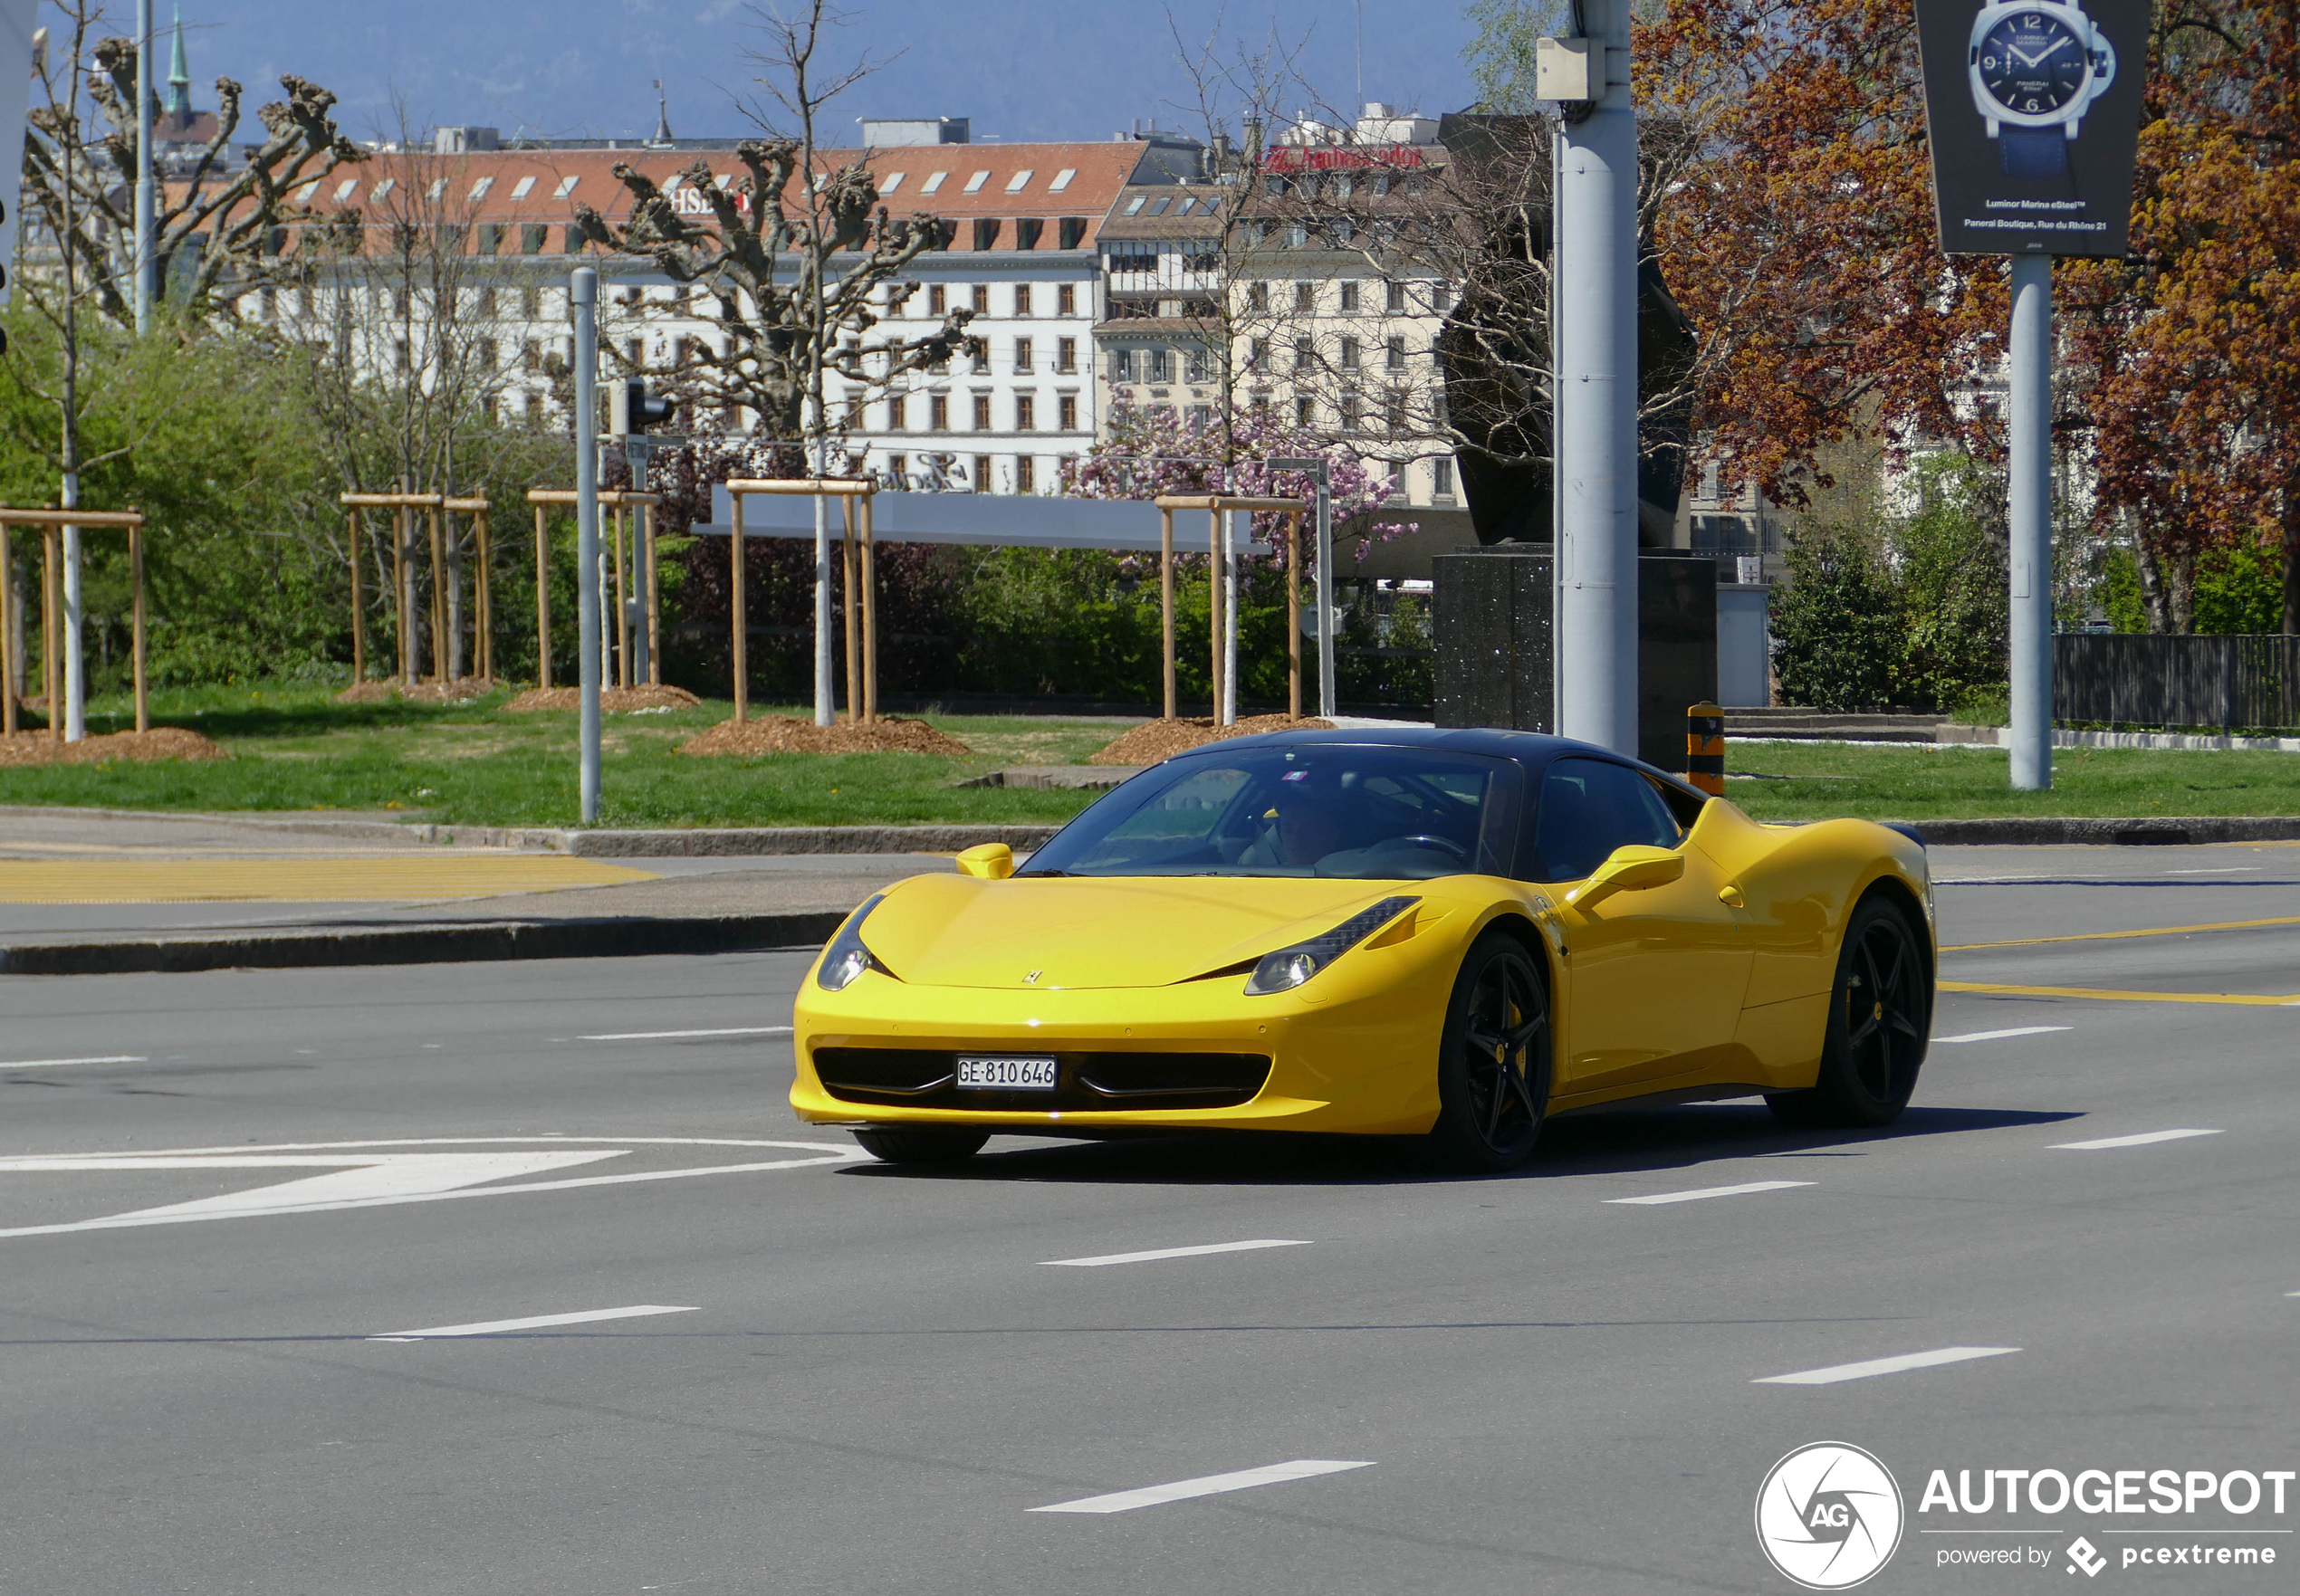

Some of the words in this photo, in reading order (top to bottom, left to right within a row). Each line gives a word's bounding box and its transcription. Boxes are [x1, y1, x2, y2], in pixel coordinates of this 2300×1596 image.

[2024, 14, 2042, 29] 12
[1984, 56, 1996, 70] 9
[2027, 99, 2038, 112] 6
[1986, 199, 2020, 208] Luminor
[2021, 200, 2049, 209] Marina
[1964, 218, 1996, 228] Panerai
[1998, 219, 2036, 230] Boutique,
[2037, 220, 2055, 228] Rue
[2056, 221, 2067, 229] du
[2069, 221, 2095, 230] Rhône
[2096, 222, 2107, 230] 21
